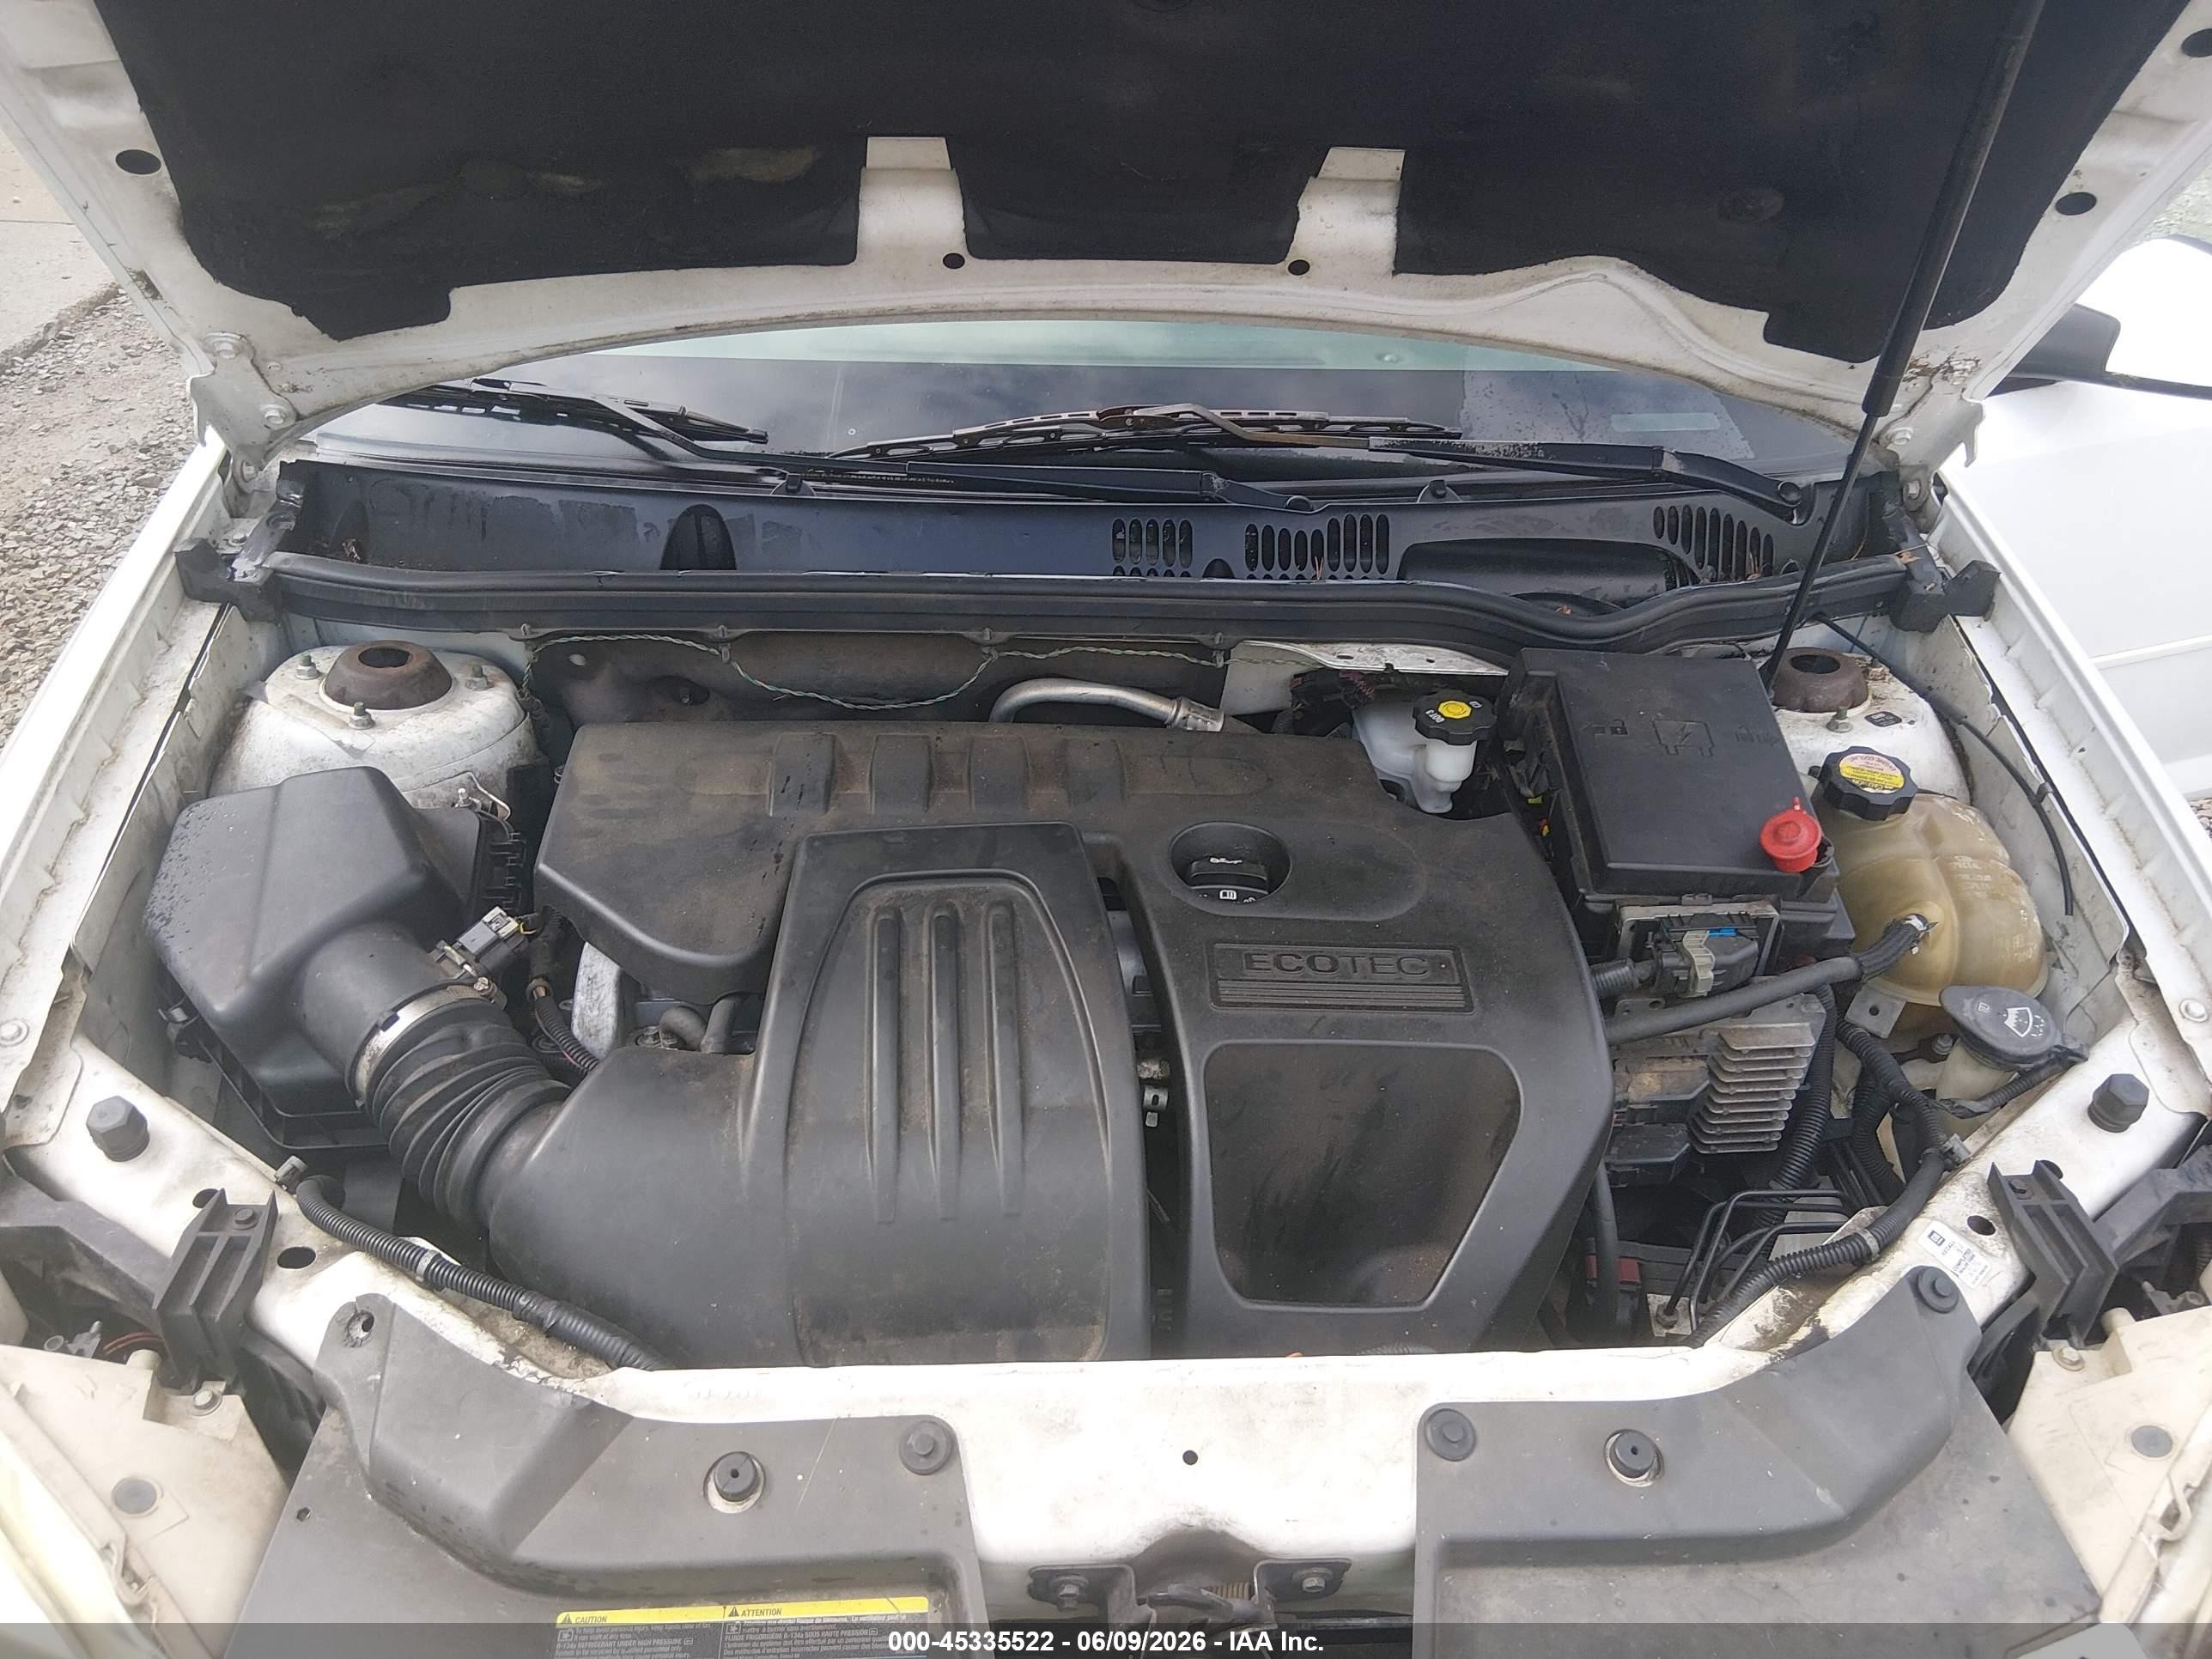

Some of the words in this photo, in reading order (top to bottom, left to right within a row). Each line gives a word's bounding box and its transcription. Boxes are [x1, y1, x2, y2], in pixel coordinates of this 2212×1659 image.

[1429, 712, 1445, 723] DOT
[1244, 952, 1429, 976] ECOTEC
[741, 1607, 782, 1617] ATTENTION
[575, 1615, 608, 1624] CAUTION
